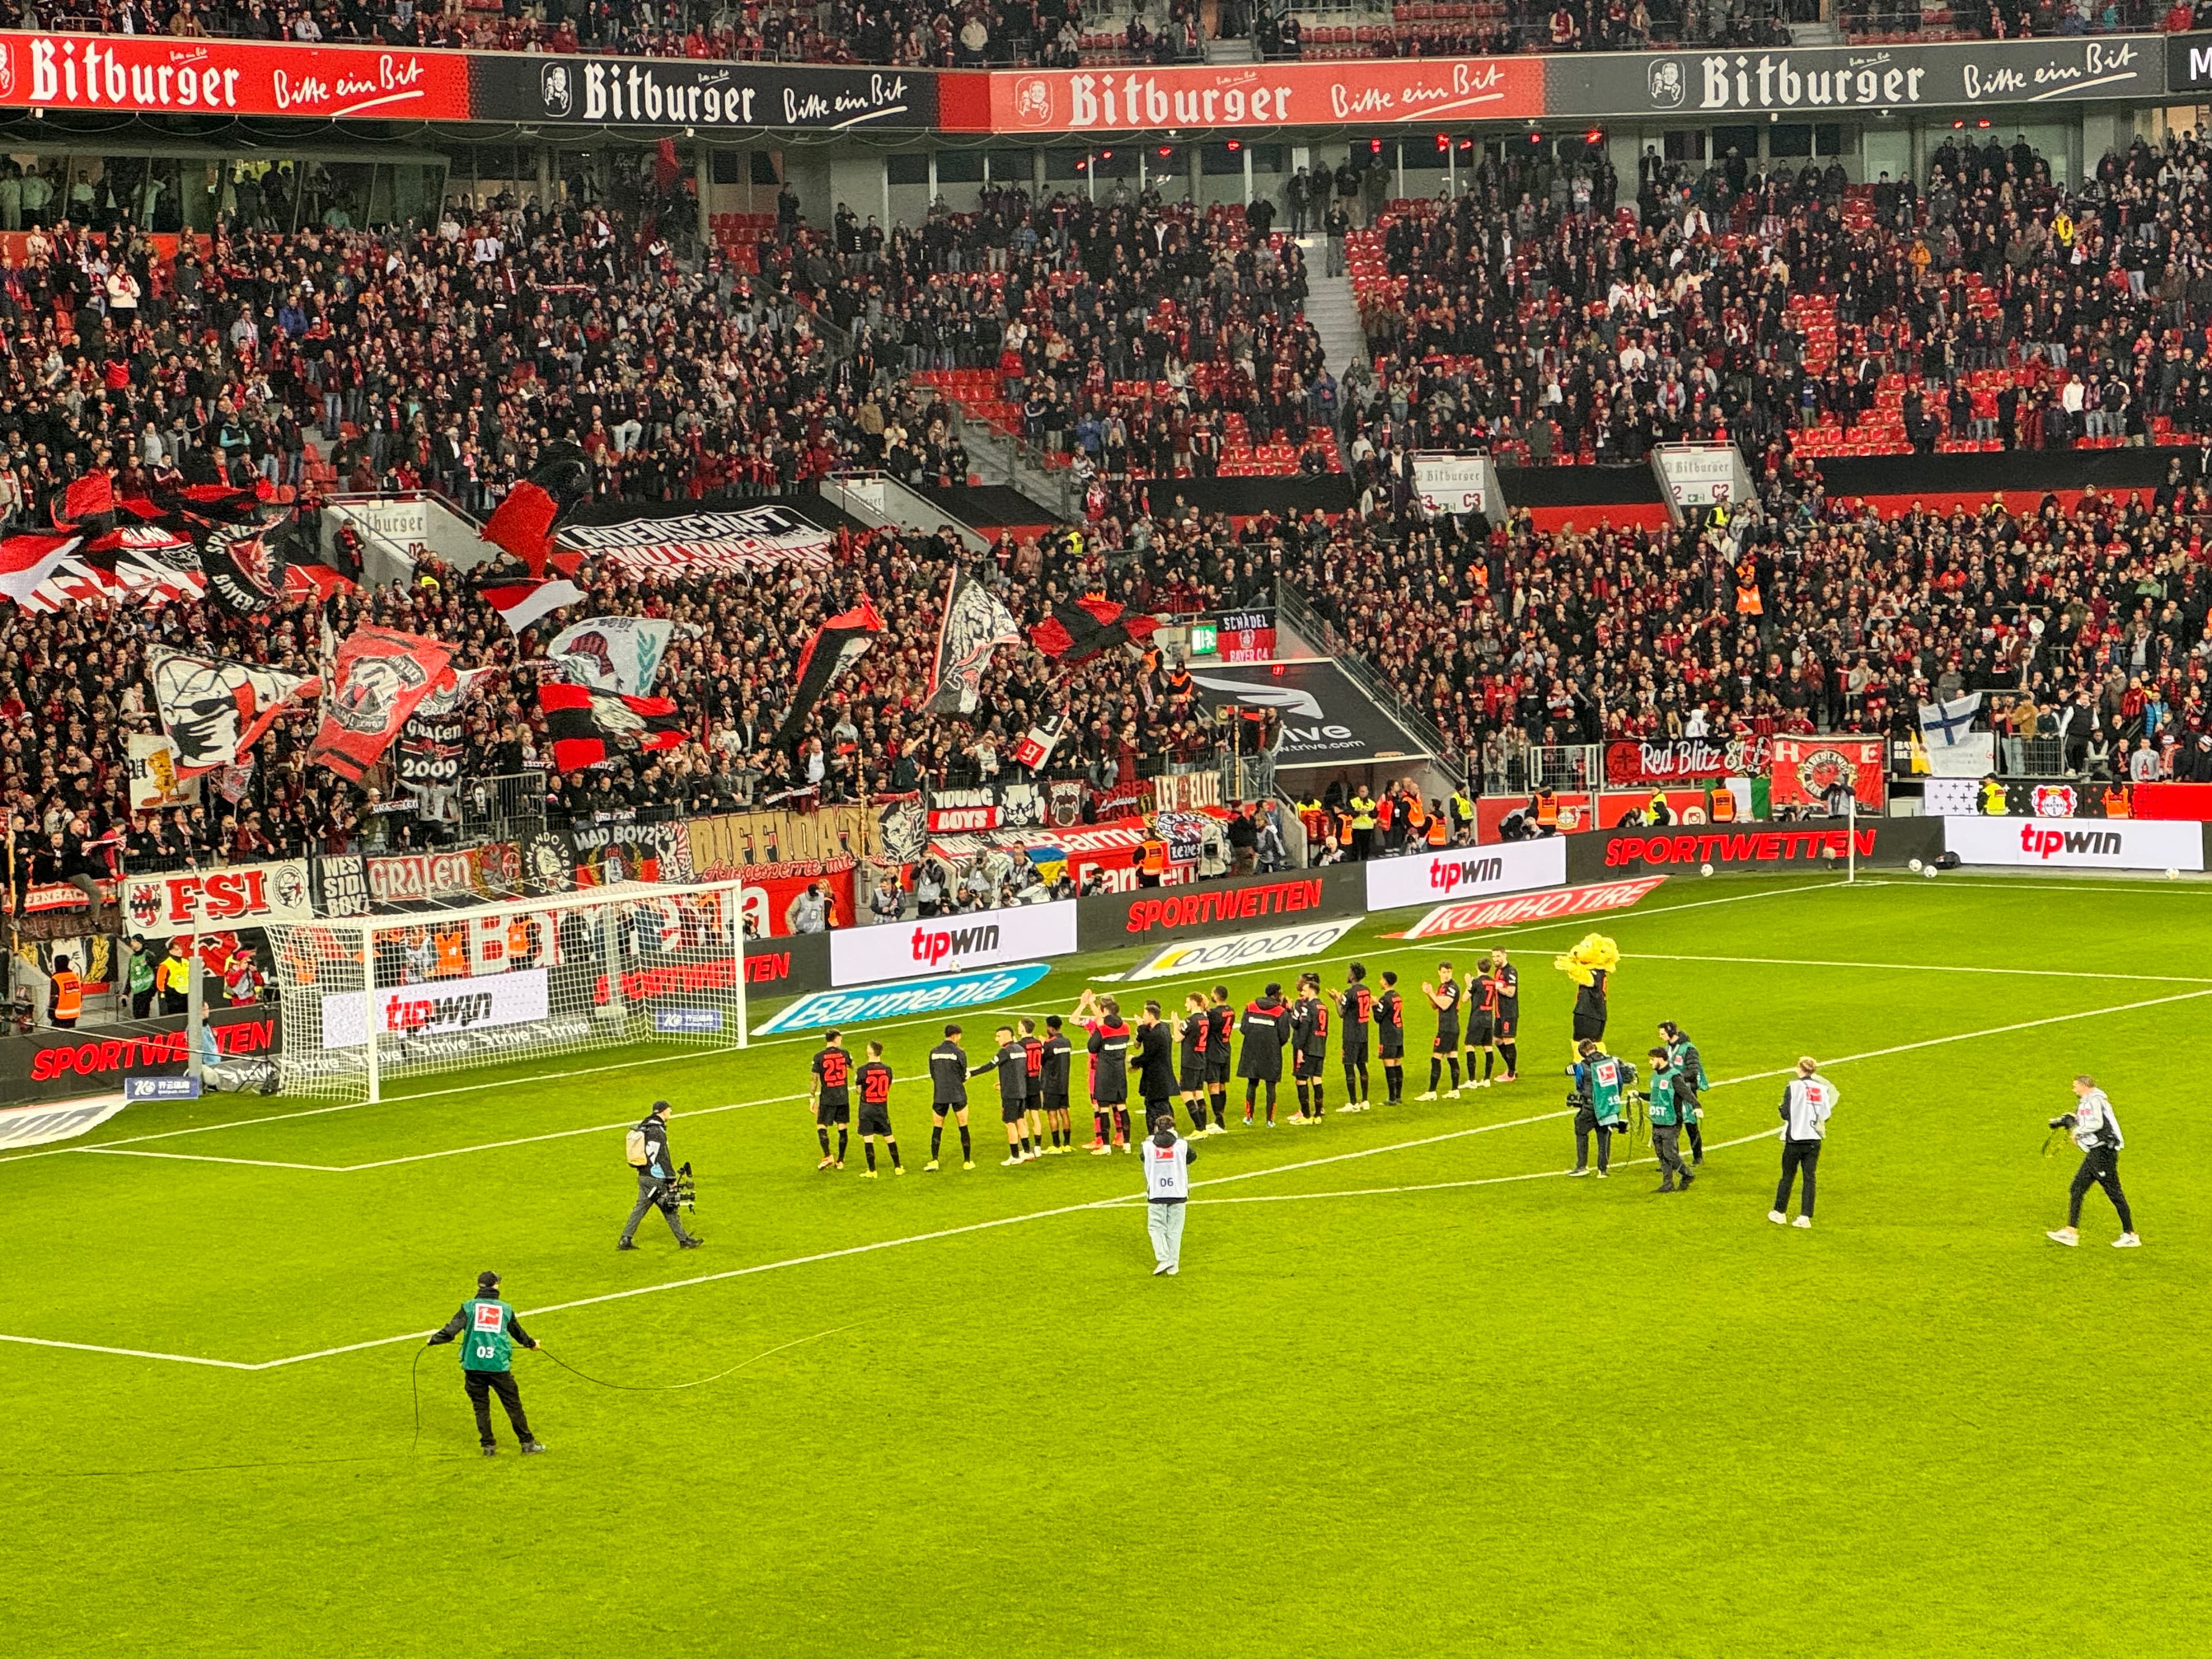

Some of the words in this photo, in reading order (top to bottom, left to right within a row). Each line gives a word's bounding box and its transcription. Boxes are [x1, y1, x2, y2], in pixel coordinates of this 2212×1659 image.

[28, 38, 240, 108] Bitburger
[274, 69, 329, 109] Bitte
[336, 78, 377, 96] ein
[381, 55, 425, 89] Bit
[1699, 56, 1925, 109] Bitburger
[1963, 63, 2026, 99] Bitte
[2033, 66, 2082, 86] ein
[2086, 43, 2138, 75] Bit
[583, 62, 755, 123] Bitburger
[783, 88, 830, 123] Bitte
[835, 90, 868, 109] ein
[871, 74, 908, 106] Bit
[1069, 73, 1292, 125] Bitburger
[1331, 82, 1395, 118] Bitte
[1401, 85, 1448, 104] ein
[1452, 63, 1505, 93] Bit
[1463, 493, 1481, 508] C3
[1711, 484, 1730, 499] C2
[354, 512, 423, 533] itburger
[557, 507, 792, 549] LEIDENSCHAFT
[1278, 740, 1365, 753] w.trive.com
[1282, 725, 1352, 743] ive
[401, 758, 458, 778] 2009
[1639, 739, 1675, 775] Red
[1677, 738, 1722, 775] Blitz
[1724, 740, 1745, 771] 81
[1775, 742, 1799, 763] H
[1861, 744, 1879, 764] E
[930, 788, 994, 809] YOUNG
[1155, 777, 1177, 811] LEV
[1189, 772, 1221, 808] ELITE
[937, 809, 987, 830] BOYS
[574, 828, 609, 851] MAD
[1605, 828, 1877, 867] SPORTWETTEN
[2021, 823, 2122, 859] tipwin
[702, 859, 823, 883] Ausgesperrte
[825, 851, 856, 873] mit
[1430, 857, 1503, 893] tipwin
[165, 870, 271, 926] FSI
[1126, 878, 1322, 933] SPORTWETTEN
[1426, 895, 1572, 933] KUMHO
[1568, 881, 1657, 912] TIRE
[911, 924, 999, 967] tipwin
[782, 973, 1018, 1028] Barmenia
[1358, 995, 1370, 1018] 12
[31, 1019, 274, 1082] SPORTWETEN
[1026, 1049, 1041, 1071] 10
[823, 1058, 846, 1081] 25
[865, 1075, 889, 1097] 20
[1649, 1105, 1666, 1116] OST
[1160, 1177, 1174, 1187] 06
[476, 1346, 495, 1359] 03
